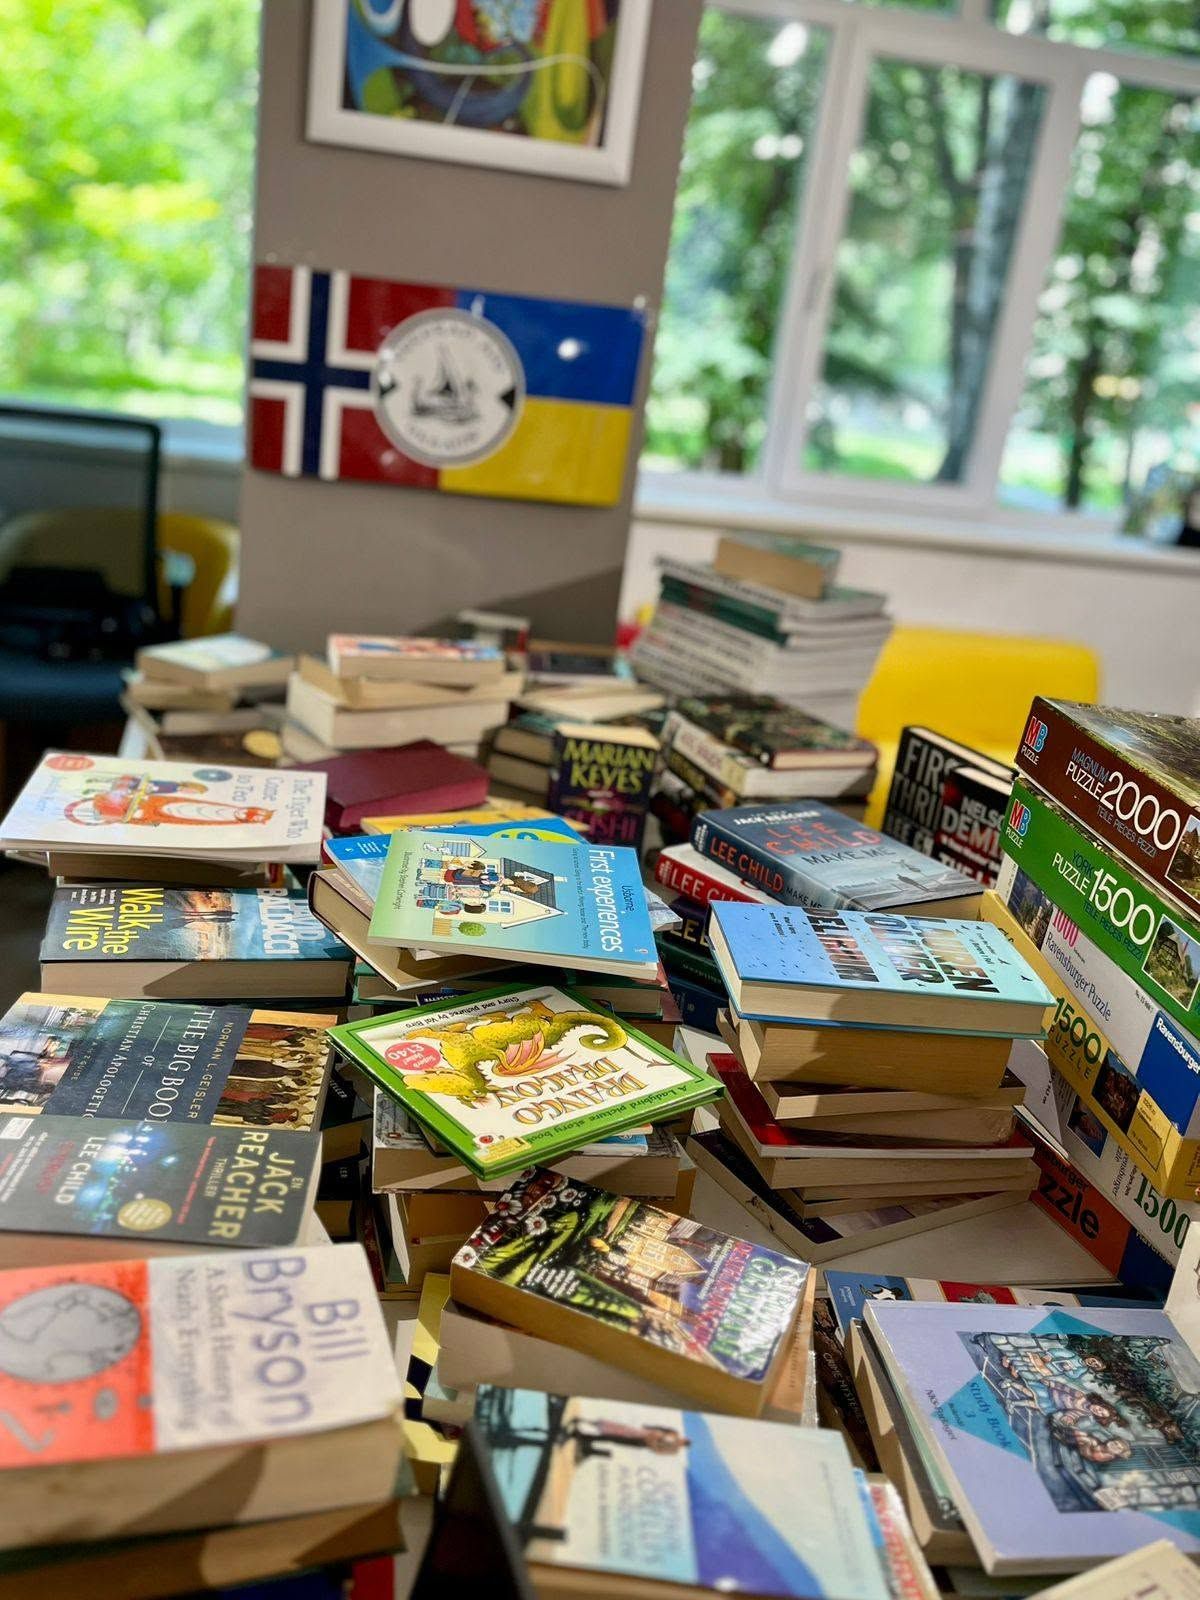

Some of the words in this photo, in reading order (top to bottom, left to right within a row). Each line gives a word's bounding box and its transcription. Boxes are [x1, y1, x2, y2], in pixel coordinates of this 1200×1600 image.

[1025, 715, 1048, 753] MB
[563, 738, 655, 771] MARIAN
[1020, 744, 1040, 766] PUZZLE
[1071, 747, 1110, 784] MAGNUM
[570, 762, 644, 794] KEYES
[1008, 799, 1031, 837] MB
[1065, 761, 1105, 801] PUZZLE
[1100, 771, 1180, 851] 2000
[765, 830, 883, 856] CHILD
[766, 822, 838, 839] LEE
[941, 805, 1004, 859] DEMI
[1005, 825, 1024, 849] PUZZLE
[588, 849, 616, 874] First
[709, 836, 737, 865] LEE
[738, 855, 785, 894] CHILD
[785, 887, 808, 907] MAKE
[801, 849, 865, 866] MAKE
[866, 846, 897, 859] ME
[670, 868, 704, 899] LEE
[1052, 852, 1090, 895] PUZZLE
[1088, 868, 1155, 945] 1500
[62, 907, 115, 950] Wire
[117, 888, 164, 930] Walk
[256, 888, 300, 955] BALDACCI
[586, 875, 624, 953] experiences
[101, 930, 140, 954] the
[1088, 982, 1112, 1022] Puzzle
[118, 1004, 157, 1052] CHRISTIAN
[182, 1009, 216, 1040] THE
[210, 1022, 235, 1060] NORMAN
[1053, 996, 1101, 1064] 1500
[141, 1054, 156, 1067] OF
[168, 1043, 200, 1072] BIG
[1049, 1028, 1092, 1080] PUZZLE
[144, 1076, 185, 1124] BOO
[187, 1073, 214, 1120] GEISLER
[494, 1057, 624, 1109] DRAGON
[512, 1072, 648, 1125] DRANGO
[629, 1090, 677, 1110] Ladybird
[554, 1119, 586, 1135] story
[589, 1104, 627, 1123] picture
[78, 1136, 107, 1159] LEE
[54, 1162, 92, 1204] CHILD
[203, 1157, 228, 1198] THRILLER
[208, 1131, 270, 1239] REACHER
[253, 1151, 296, 1215] JACK
[1133, 1172, 1191, 1250] 1500
[228, 1256, 313, 1425] Bryson
[304, 1298, 371, 1362] Bill
[986, 1417, 1012, 1449] Book
